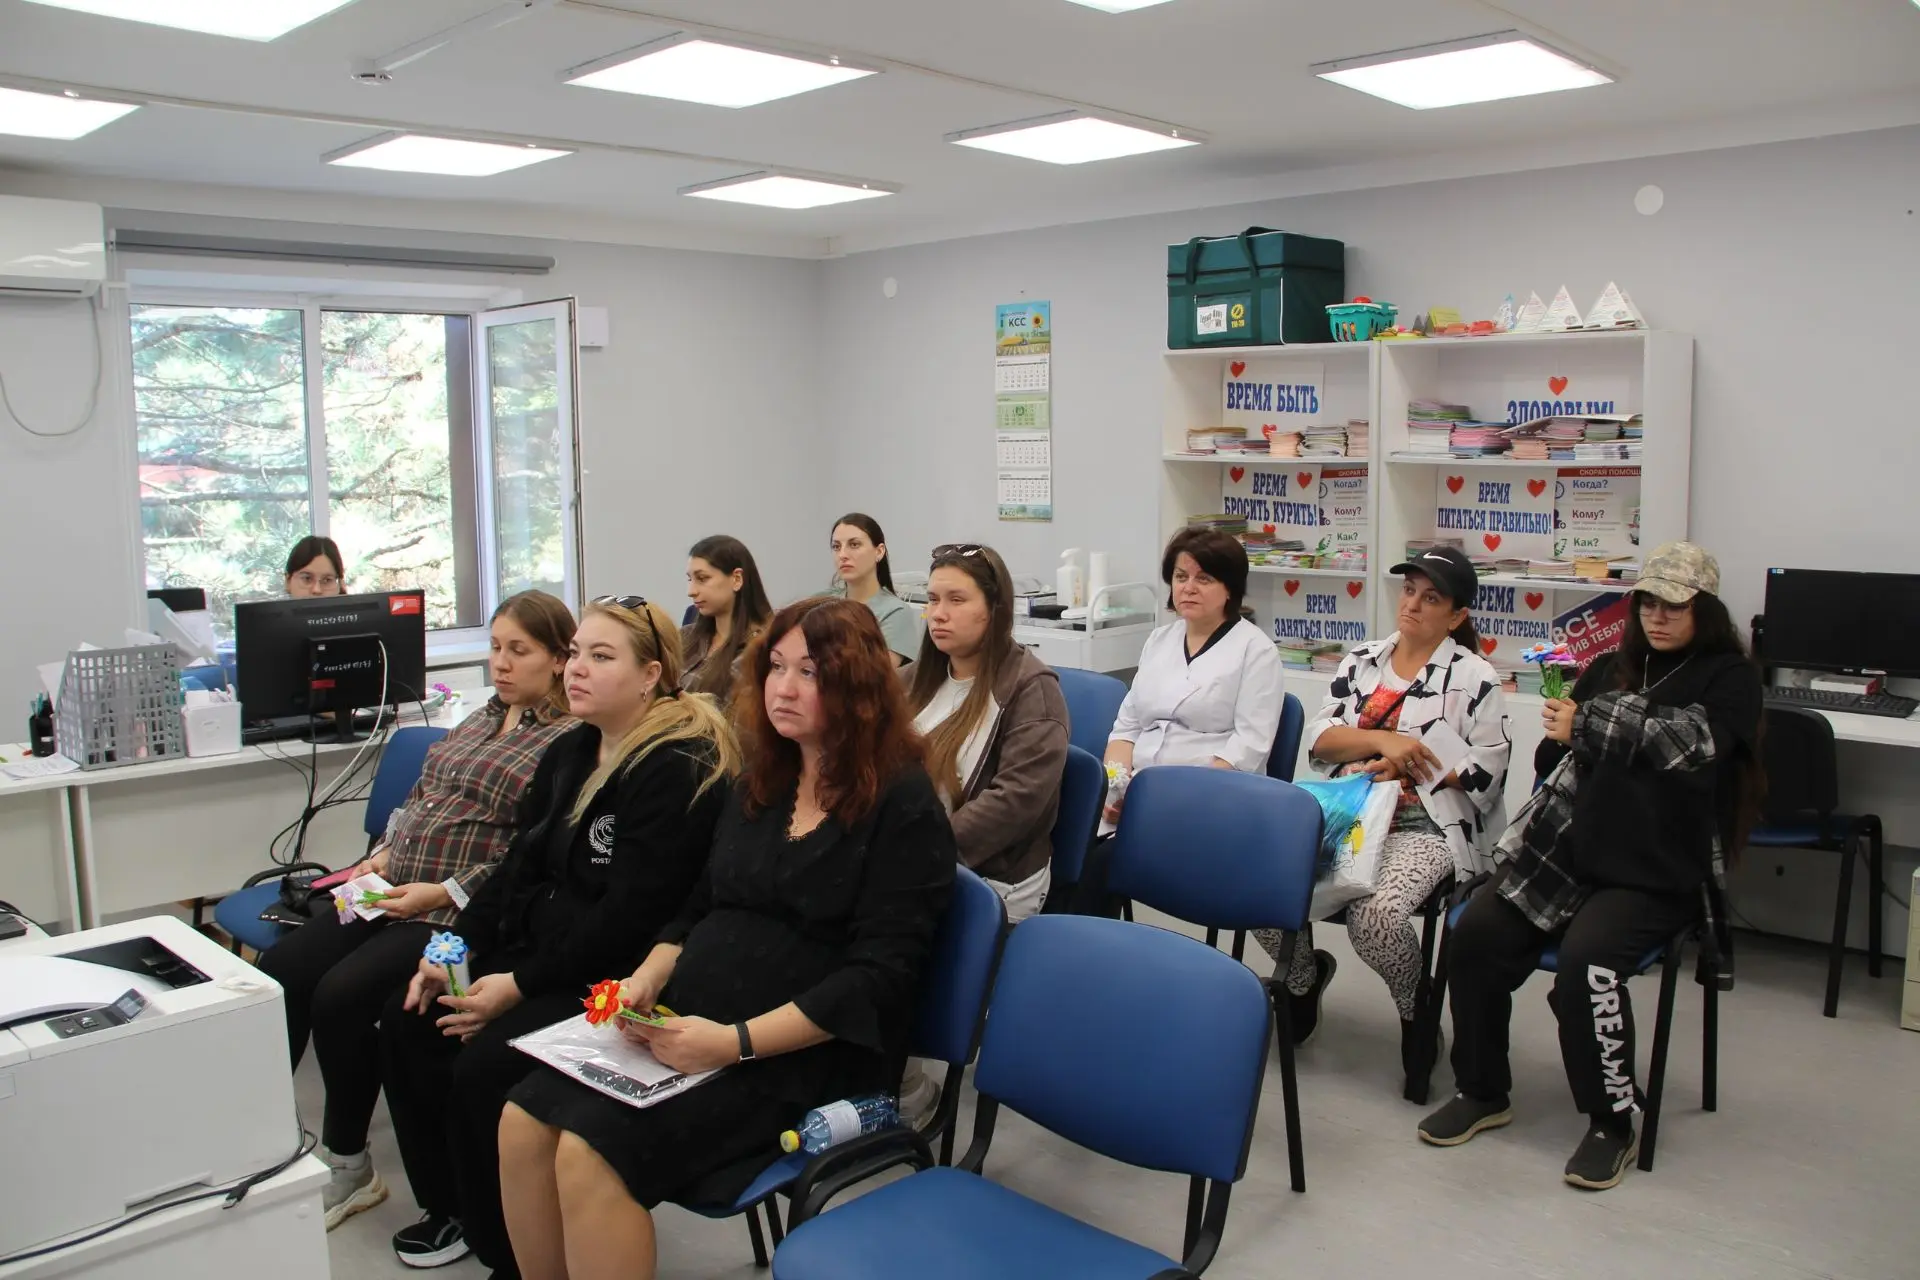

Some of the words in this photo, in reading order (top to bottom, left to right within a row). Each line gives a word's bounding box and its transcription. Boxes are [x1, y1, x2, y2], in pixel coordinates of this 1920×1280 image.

[1227, 382, 1272, 412] ВРЕМЯ
[1276, 384, 1319, 414] БЫТЬ
[1580, 468, 1608, 476] СКОРАЯ
[1609, 468, 1641, 476] ПОМОЩ
[1252, 472, 1288, 497] ВРЕМЯ
[1333, 479, 1362, 488] Когда?
[1478, 481, 1511, 504] ВРЕМЯ
[1572, 479, 1608, 489] Когда?
[1224, 496, 1270, 522] БРОСИТЬ
[1273, 500, 1317, 527] КУРИТЬ!
[1334, 506, 1362, 516] Кому?
[1437, 507, 1486, 531] ПИТАТЬСЯ
[1489, 510, 1552, 535] ПРАВИЛЬНО!
[1572, 509, 1605, 519] Кому?
[1336, 532, 1358, 541] Как?
[1573, 537, 1599, 547] Как?
[1306, 594, 1337, 614] ВРЕМЯ
[1274, 618, 1322, 638] ЗАНЯТЬСЯ
[1493, 618, 1505, 635] ОТ
[1507, 619, 1549, 639] СТРЕССА!
[1552, 609, 1600, 645] ВСЕ
[1590, 619, 1625, 643] ТЕБЯ?
